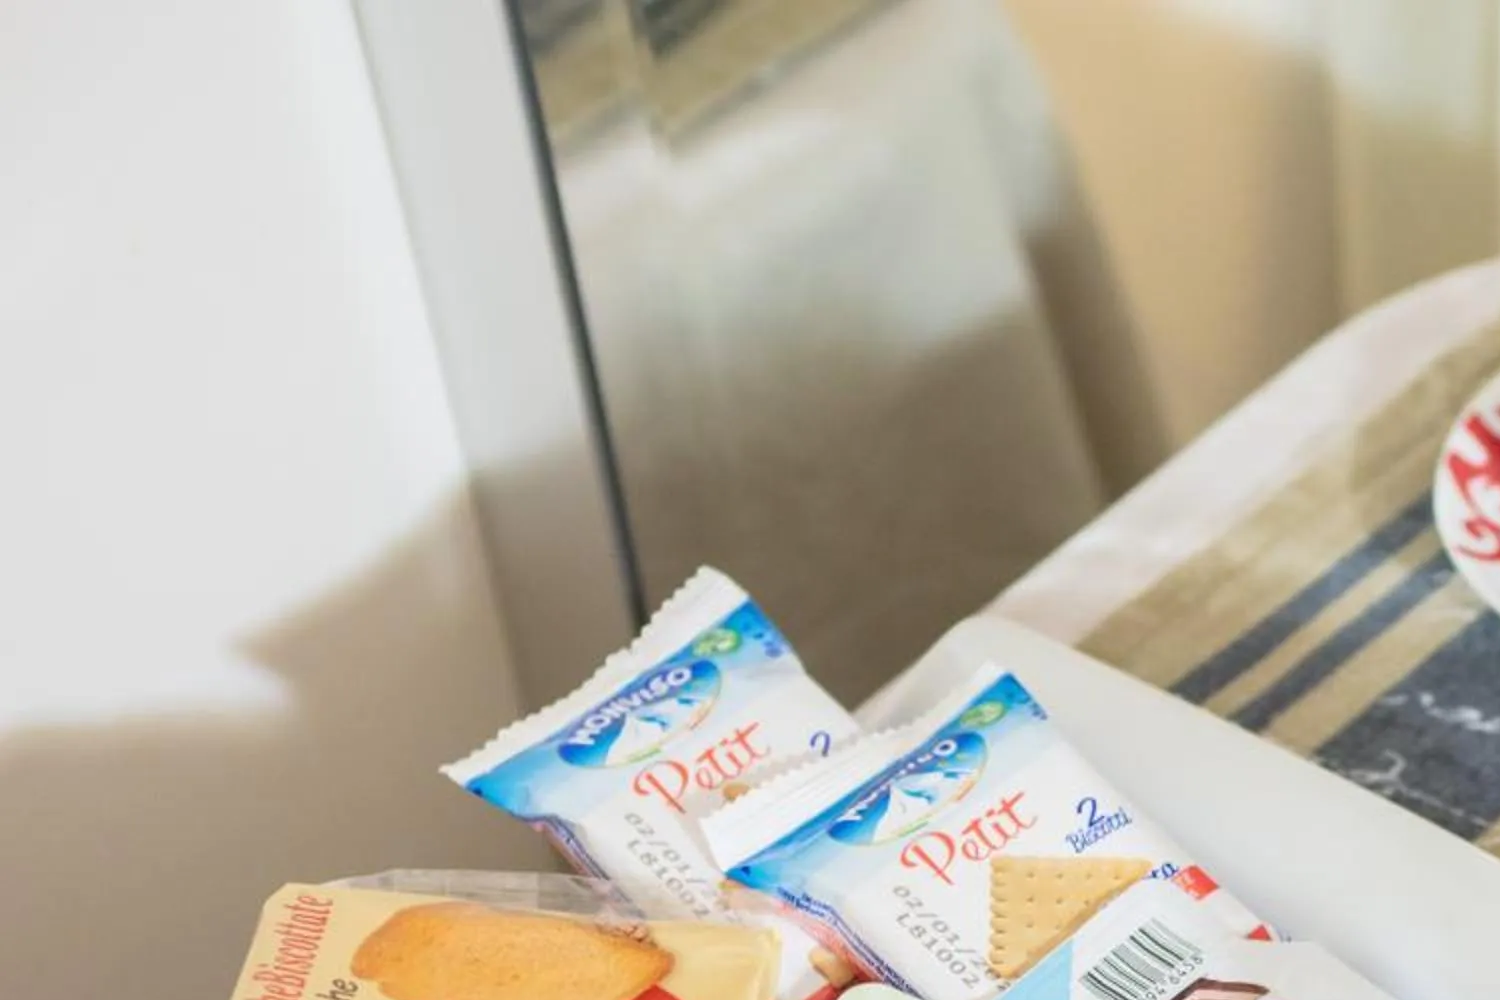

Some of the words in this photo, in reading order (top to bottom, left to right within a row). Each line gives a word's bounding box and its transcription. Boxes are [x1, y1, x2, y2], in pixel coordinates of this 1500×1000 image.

[632, 722, 770, 813] Petit
[900, 791, 1038, 886] Petit
[1077, 796, 1105, 828] 2
[895, 911, 981, 989] L81002
